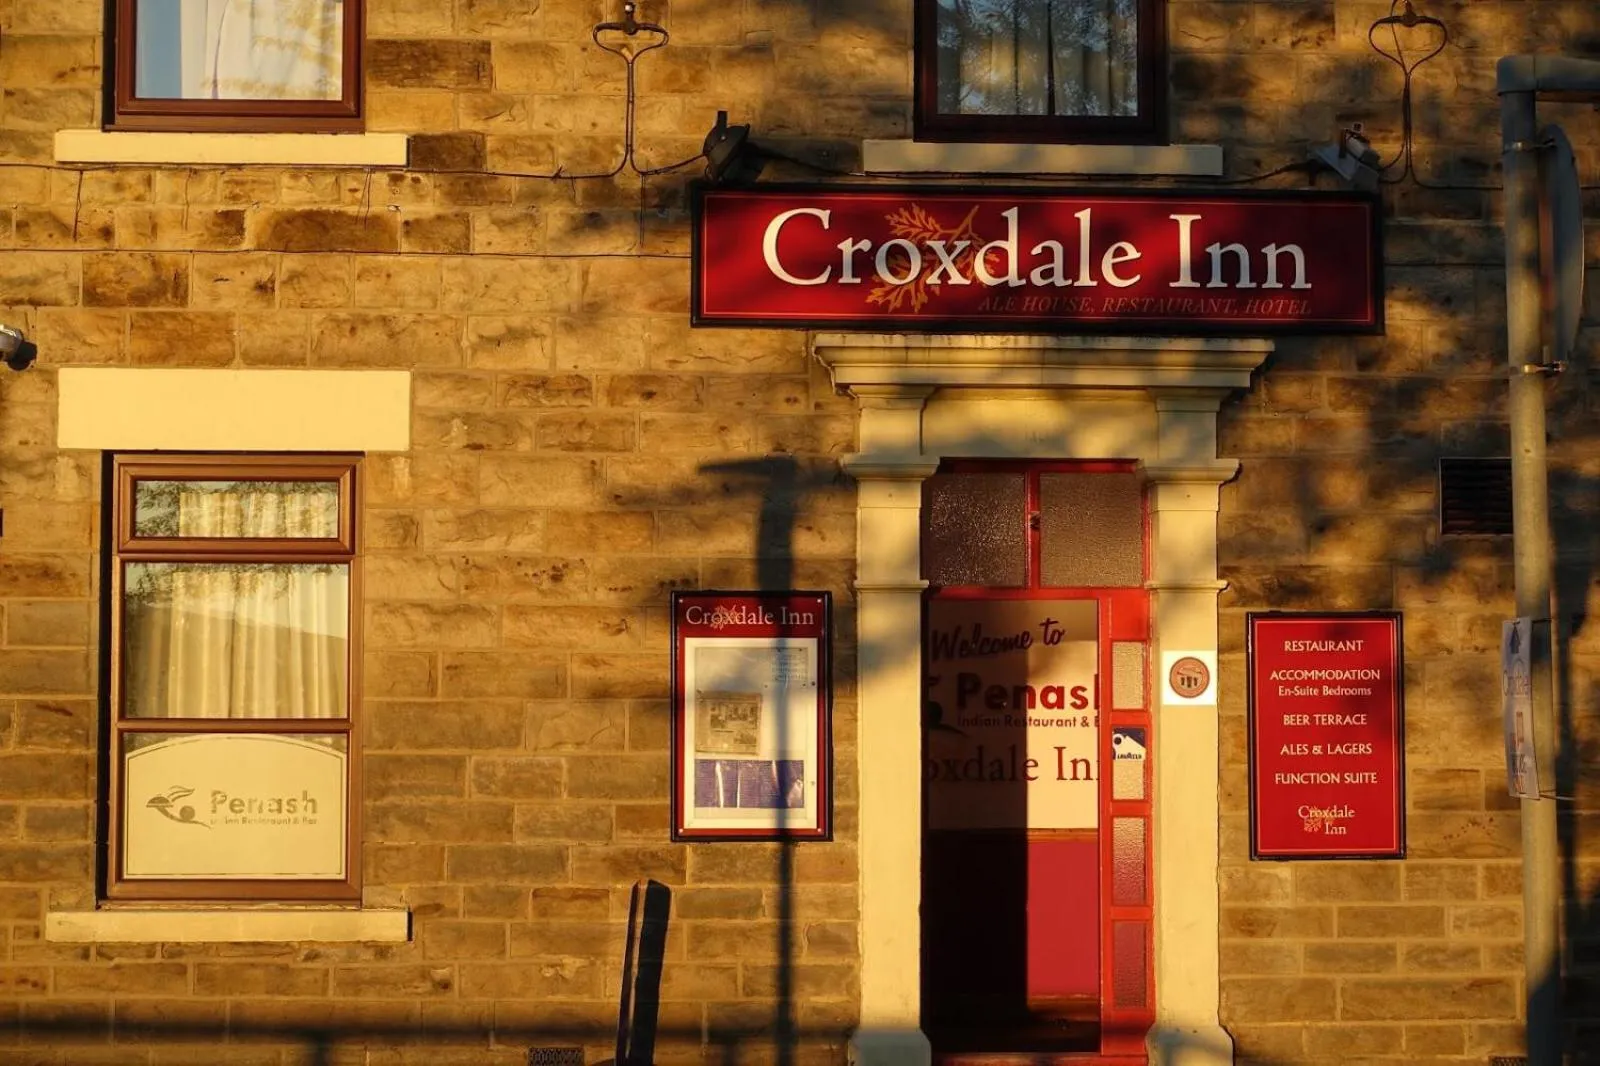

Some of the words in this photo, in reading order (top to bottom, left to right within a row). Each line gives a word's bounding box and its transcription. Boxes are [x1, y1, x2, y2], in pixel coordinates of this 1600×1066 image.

[761, 206, 1142, 290] Croxdale
[1168, 213, 1312, 290] Inn
[977, 297, 1016, 312] ALE
[1022, 297, 1096, 314] HOUSE,
[1102, 297, 1239, 316] RESTAURANT,
[1245, 299, 1312, 316] HOTEL
[685, 605, 775, 625] Croxdale
[781, 607, 815, 625] Inn
[931, 623, 1034, 661] Welcome
[1039, 617, 1067, 646] to
[1284, 640, 1364, 652] RESTAURANT
[1270, 669, 1381, 681] ACCOMMODATION
[1278, 685, 1319, 696] En-Suite
[1322, 685, 1372, 696] Bedrooms
[957, 715, 1000, 727] Indian
[1004, 715, 1077, 728] Restaurant
[1080, 716, 1090, 728] &
[1283, 714, 1310, 726] BEER
[1313, 714, 1367, 725] TERRACE
[1280, 744, 1309, 755] ALES
[1312, 745, 1323, 755] &
[1327, 744, 1373, 755] LAGERS
[1275, 773, 1341, 784] FUNCTION
[1344, 772, 1378, 784] SUITE
[210, 790, 317, 814] Penash
[1298, 805, 1355, 819] Croxdale
[1324, 823, 1347, 835] Inn
